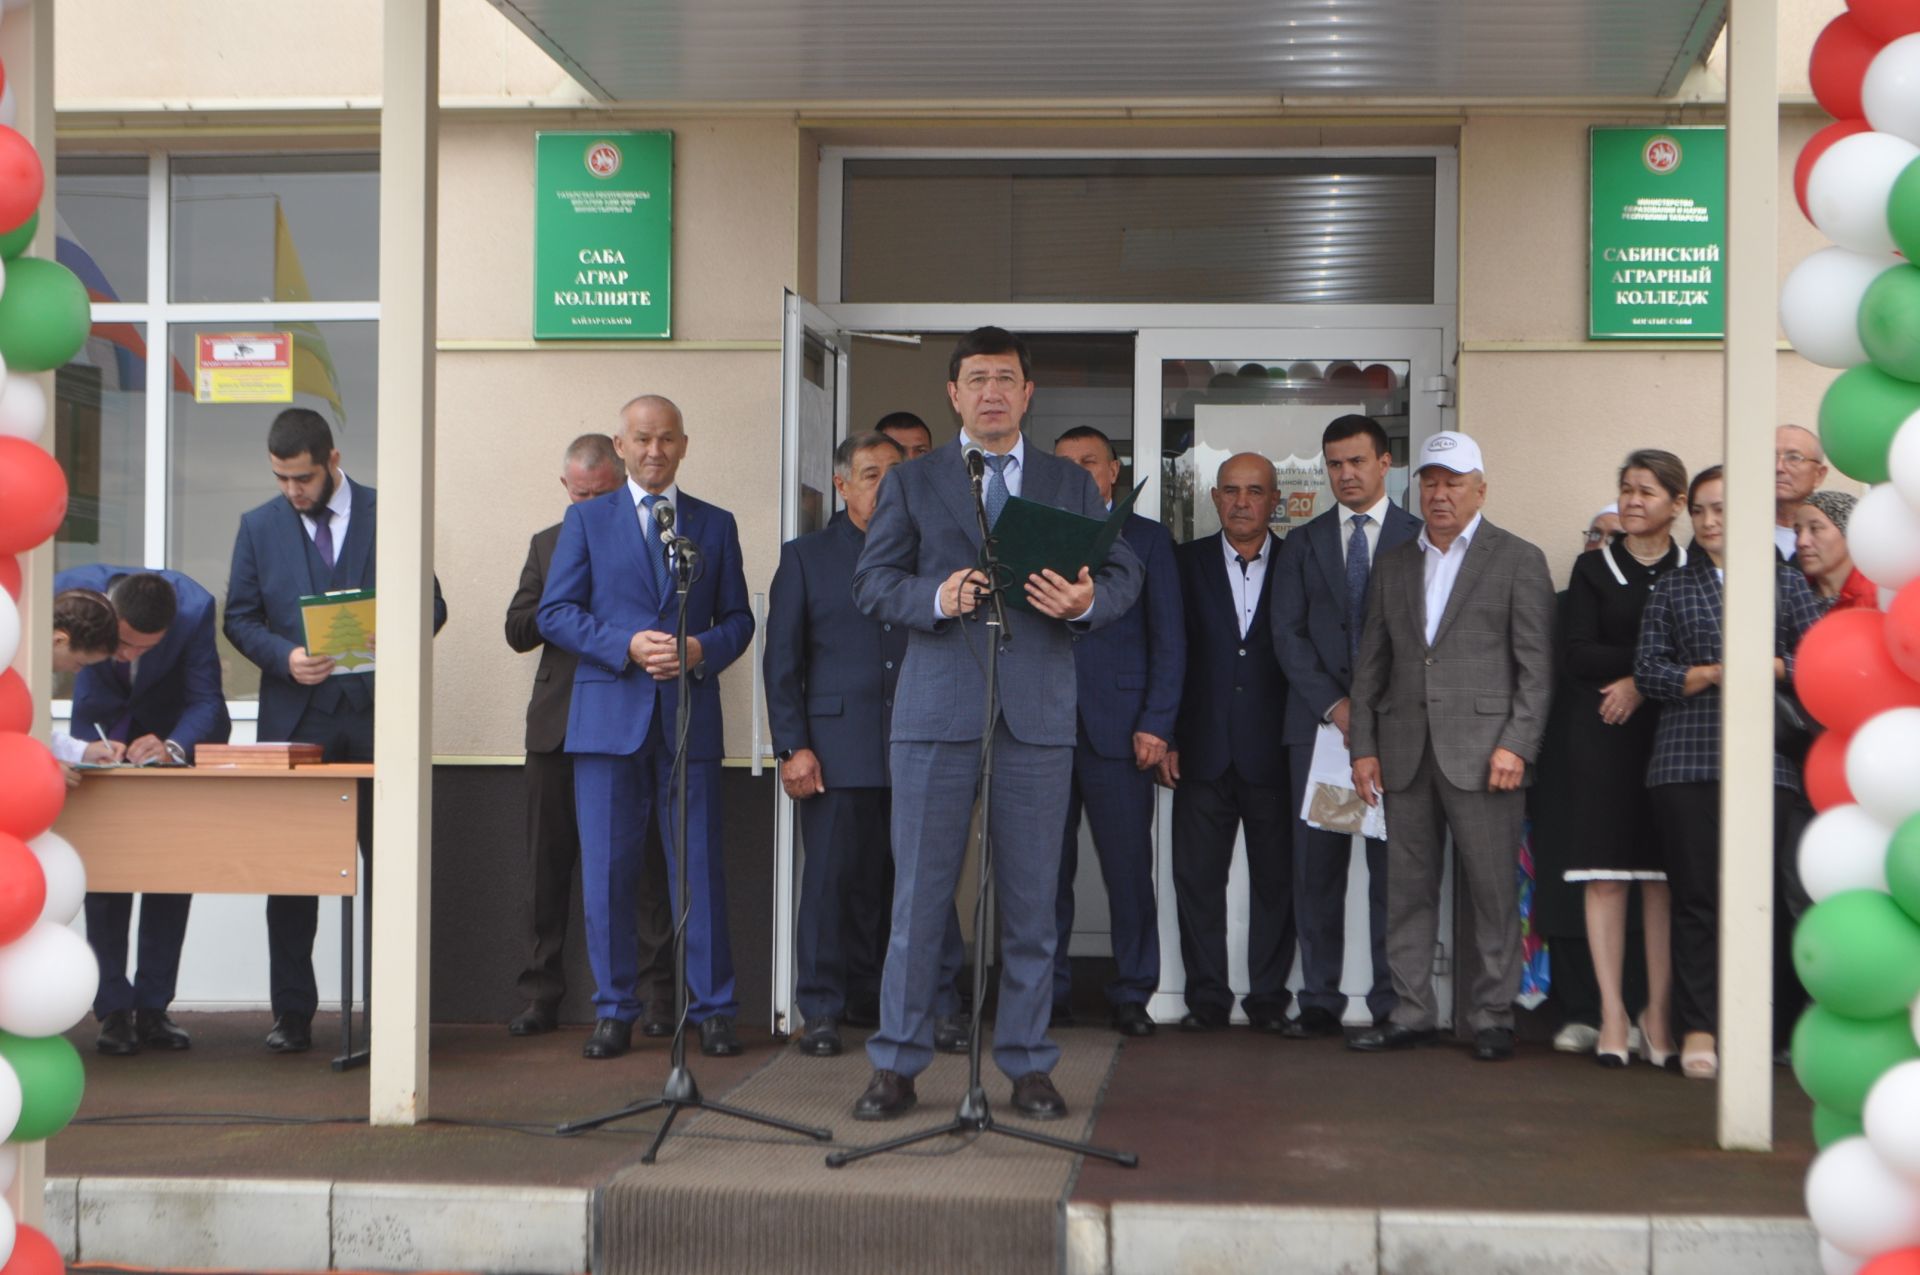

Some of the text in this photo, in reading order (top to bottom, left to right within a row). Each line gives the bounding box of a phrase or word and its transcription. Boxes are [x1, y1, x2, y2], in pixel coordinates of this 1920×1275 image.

[578, 248, 626, 265] САБА
[1603, 244, 1720, 262] САБИНСКИЙ
[575, 269, 629, 285] АГРАР
[1612, 266, 1712, 284] АГРАРНЫЙ
[1616, 290, 1709, 306] КОЛЛЕДЖ
[1289, 498, 1312, 512] 20
